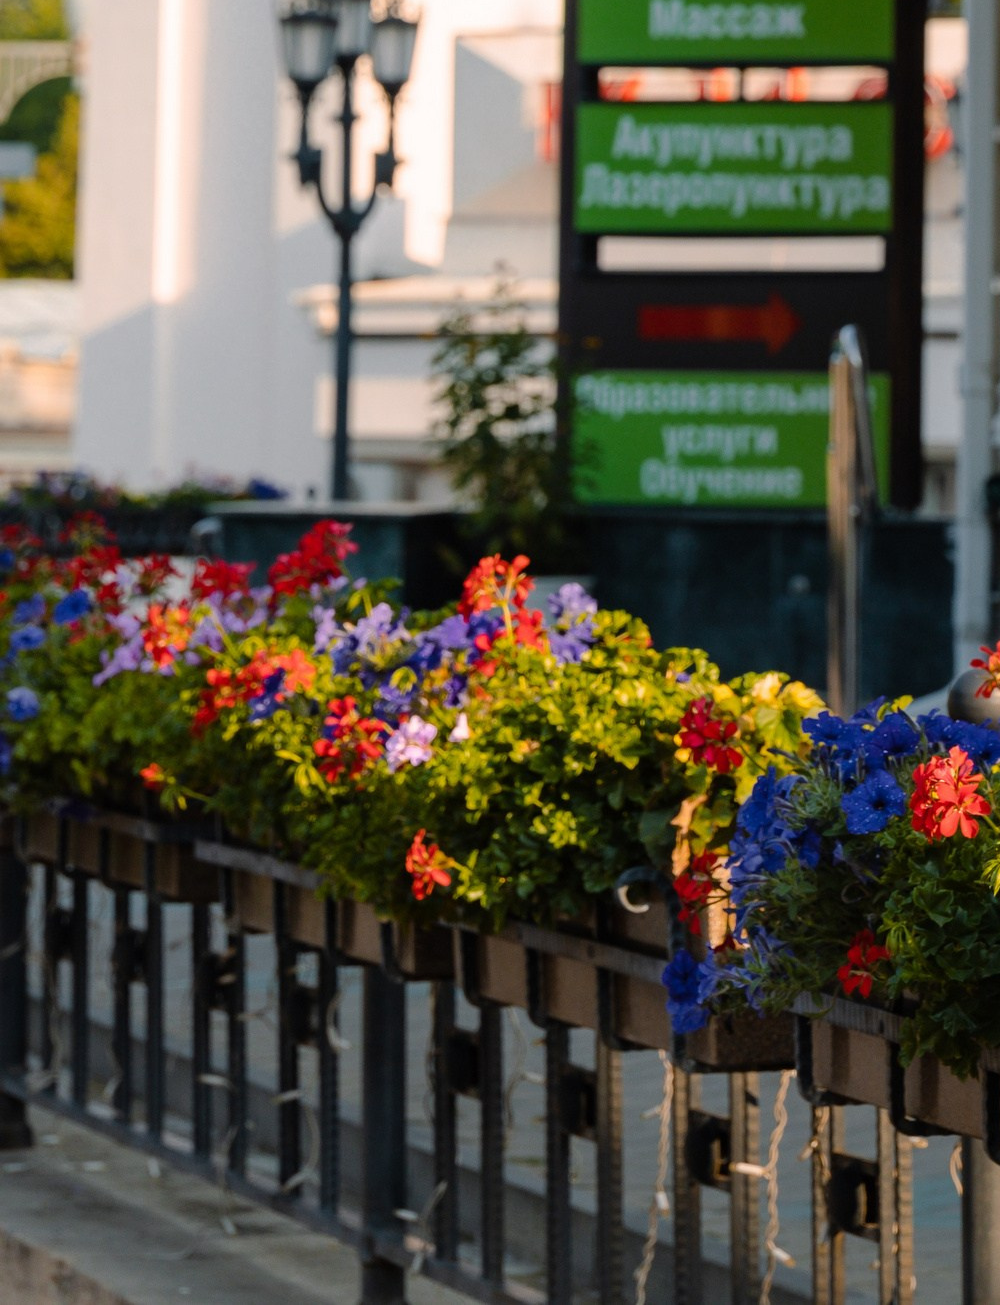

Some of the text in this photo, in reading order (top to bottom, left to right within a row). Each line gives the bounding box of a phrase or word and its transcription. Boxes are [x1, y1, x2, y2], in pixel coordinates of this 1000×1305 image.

[611, 114, 854, 168] Акупунктура
[580, 163, 890, 219] Лазеропунктура
[662, 425, 778, 463] услуги
[640, 458, 803, 505] Обучение
